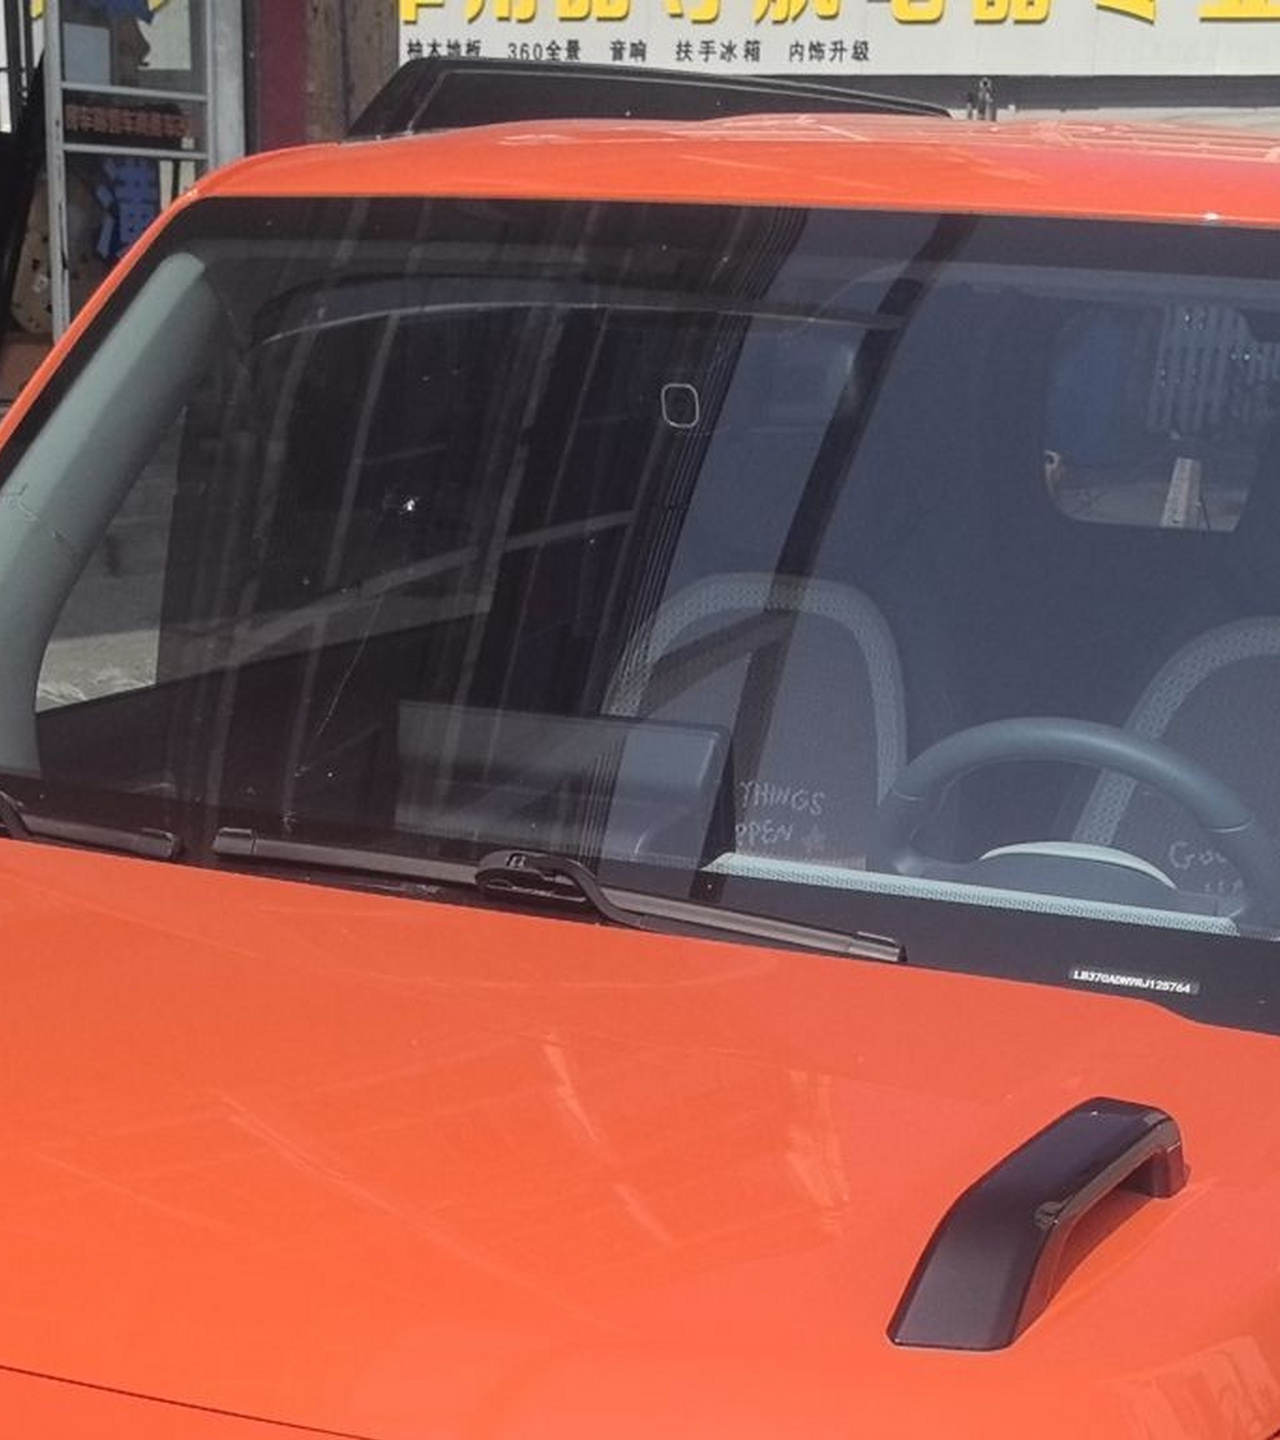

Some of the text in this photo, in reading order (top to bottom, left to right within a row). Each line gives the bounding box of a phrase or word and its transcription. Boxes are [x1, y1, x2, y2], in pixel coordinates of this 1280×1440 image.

[609, 40, 647, 62] 音响
[675, 39, 761, 62] 扶手冰箱
[788, 39, 871, 62] 内饰升级
